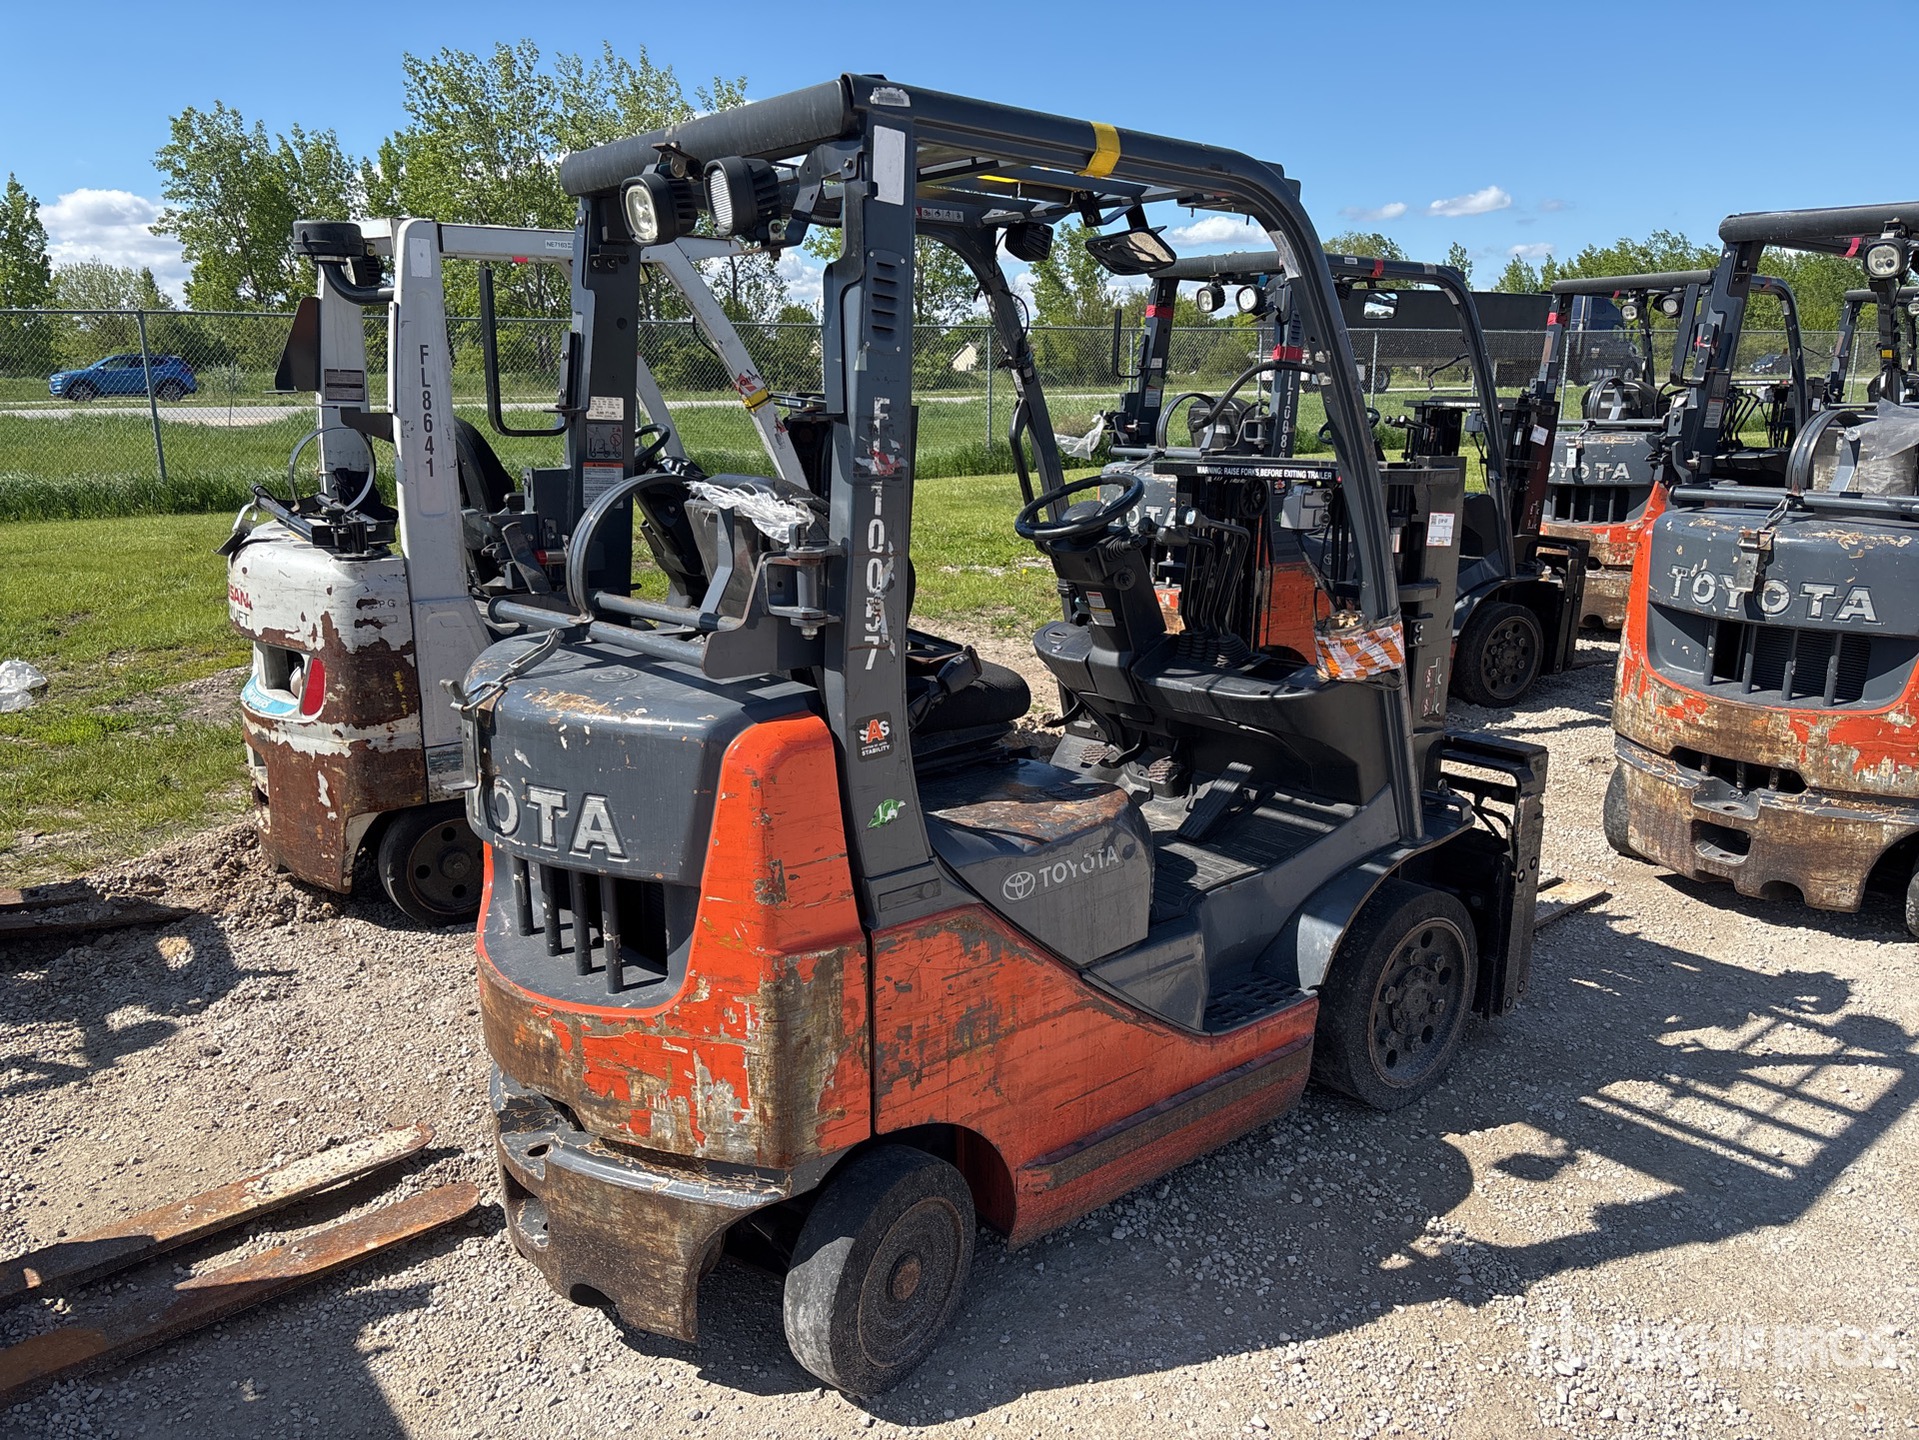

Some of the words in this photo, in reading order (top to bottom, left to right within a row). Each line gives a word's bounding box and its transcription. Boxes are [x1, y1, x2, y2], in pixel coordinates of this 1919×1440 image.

[419, 344, 435, 477] FL8641
[1197, 466, 1223, 475] WARNING:
[1223, 467, 1240, 476] RAISE
[1240, 468, 1259, 477] FORKS
[1260, 469, 1283, 478] BEFORE
[1283, 469, 1307, 479] EXITING
[1307, 470, 1333, 480] TRAILER
[1669, 564, 1884, 625] TOYOTA
[1039, 845, 1120, 887] TOYOTA
